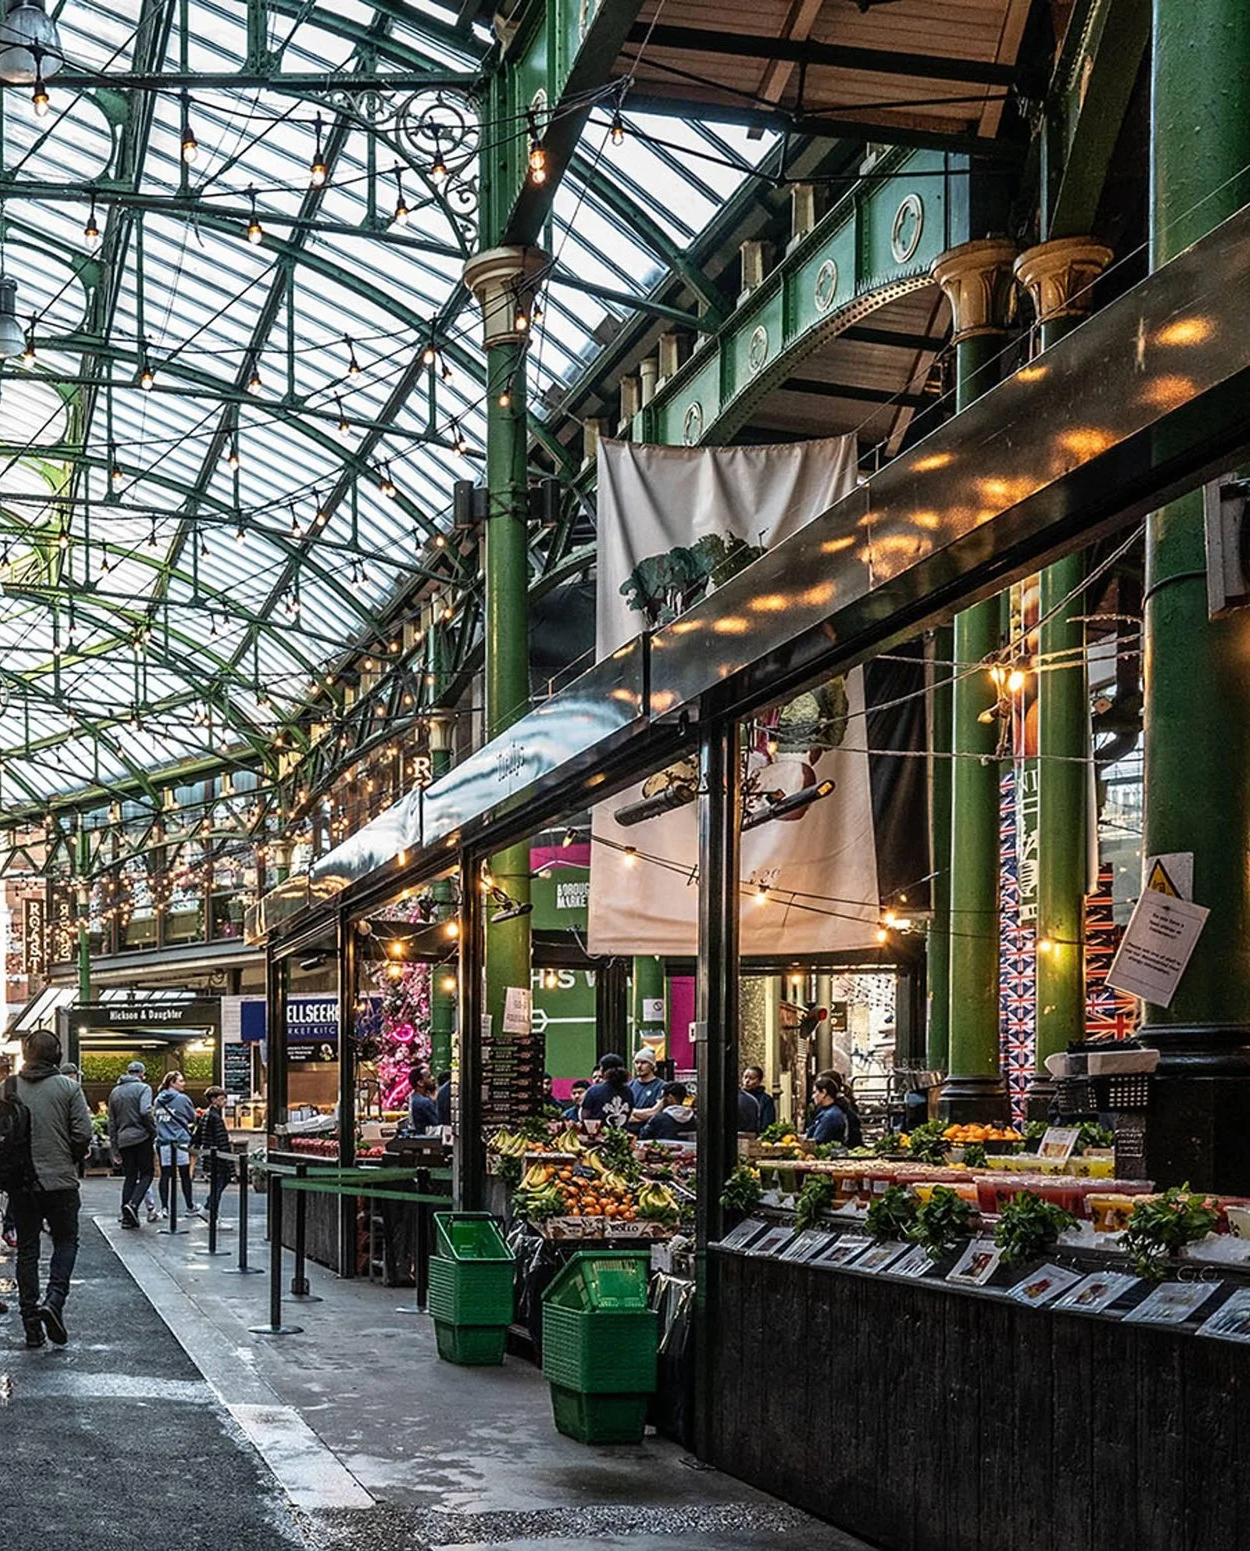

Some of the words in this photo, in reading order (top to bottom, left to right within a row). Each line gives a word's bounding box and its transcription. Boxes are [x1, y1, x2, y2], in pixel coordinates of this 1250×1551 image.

[557, 883, 590, 896] BOROUG
[557, 895, 587, 909] MARKE
[27, 902, 42, 973] ROAST
[140, 1010, 147, 1020] &
[287, 1004, 339, 1023] ELLSEEK
[287, 1027, 311, 1035] RKET
[313, 1026, 336, 1035] KITC
